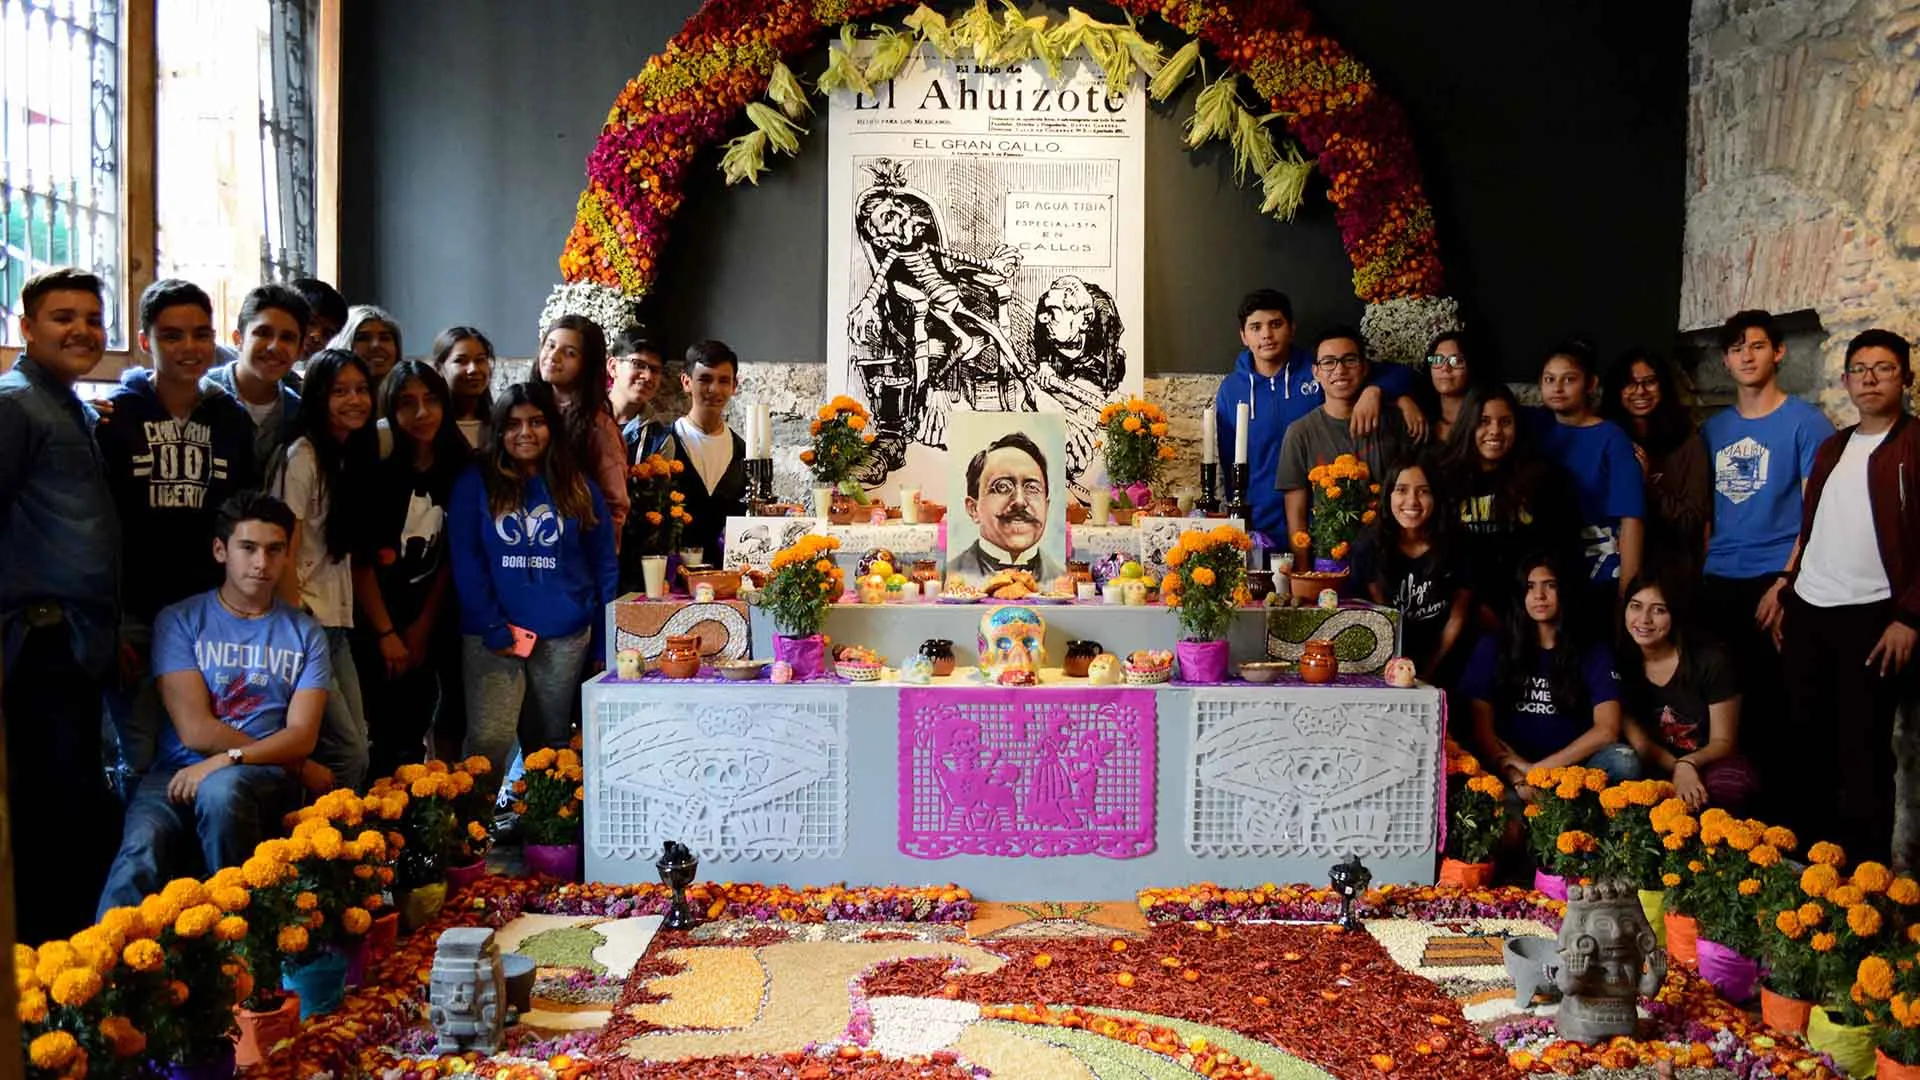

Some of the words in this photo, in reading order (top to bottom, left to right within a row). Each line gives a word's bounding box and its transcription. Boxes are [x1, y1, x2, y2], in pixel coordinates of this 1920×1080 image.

[918, 79, 1125, 113] Ahuizote
[913, 138, 936, 149] EL
[941, 139, 992, 150] GRAN
[1035, 202, 1069, 210] AGUA
[1074, 202, 1106, 211] TIBIA
[1015, 220, 1097, 229] ESPECIALISTA
[149, 483, 208, 508] LIBERTY
[1531, 690, 1552, 702] ME
